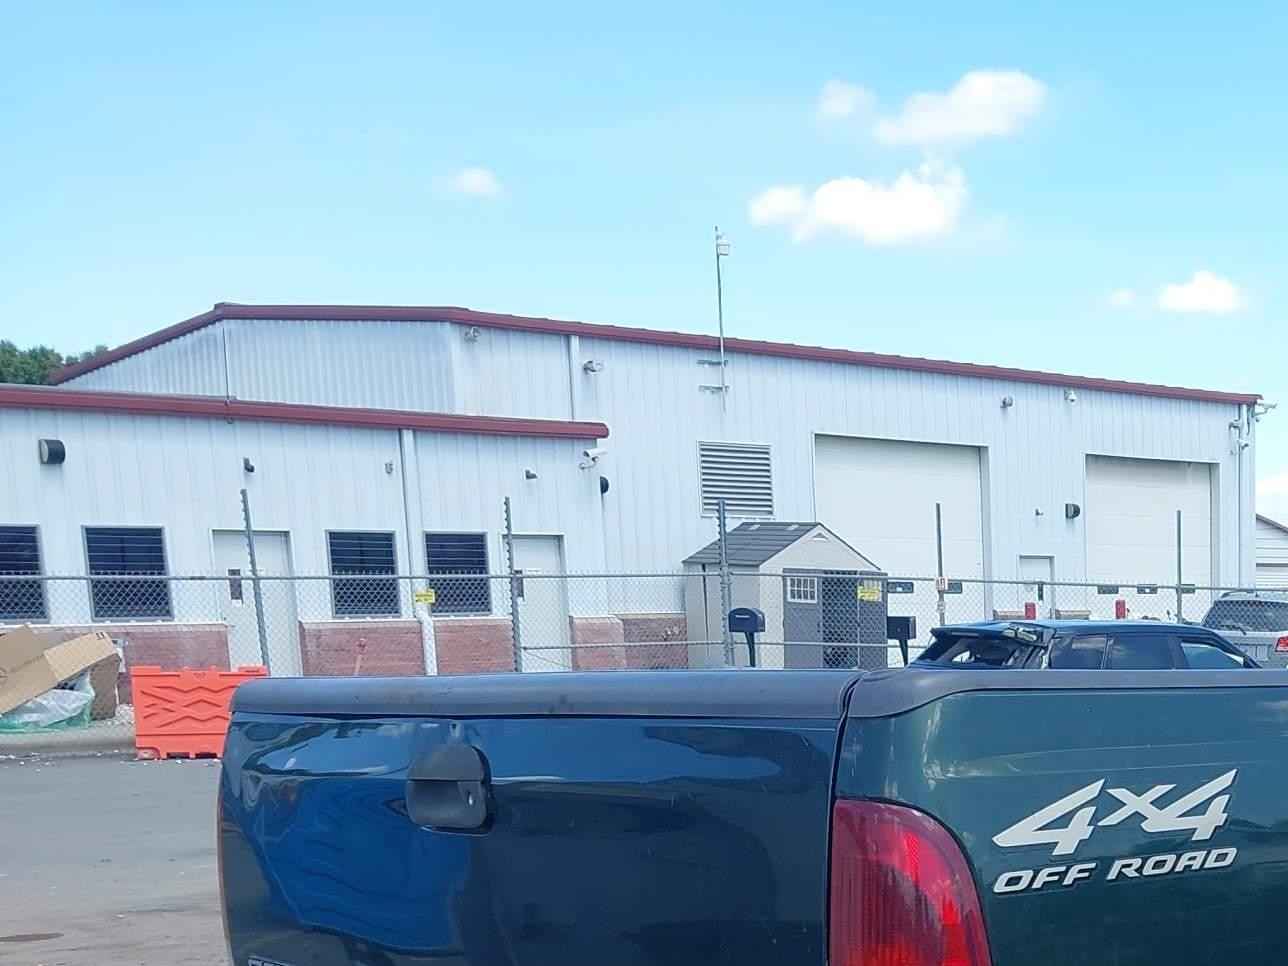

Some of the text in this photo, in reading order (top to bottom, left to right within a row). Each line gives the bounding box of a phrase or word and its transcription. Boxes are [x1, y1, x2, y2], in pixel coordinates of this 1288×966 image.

[991, 768, 1238, 856] 4x4
[993, 847, 1238, 893] OFF ROAD
